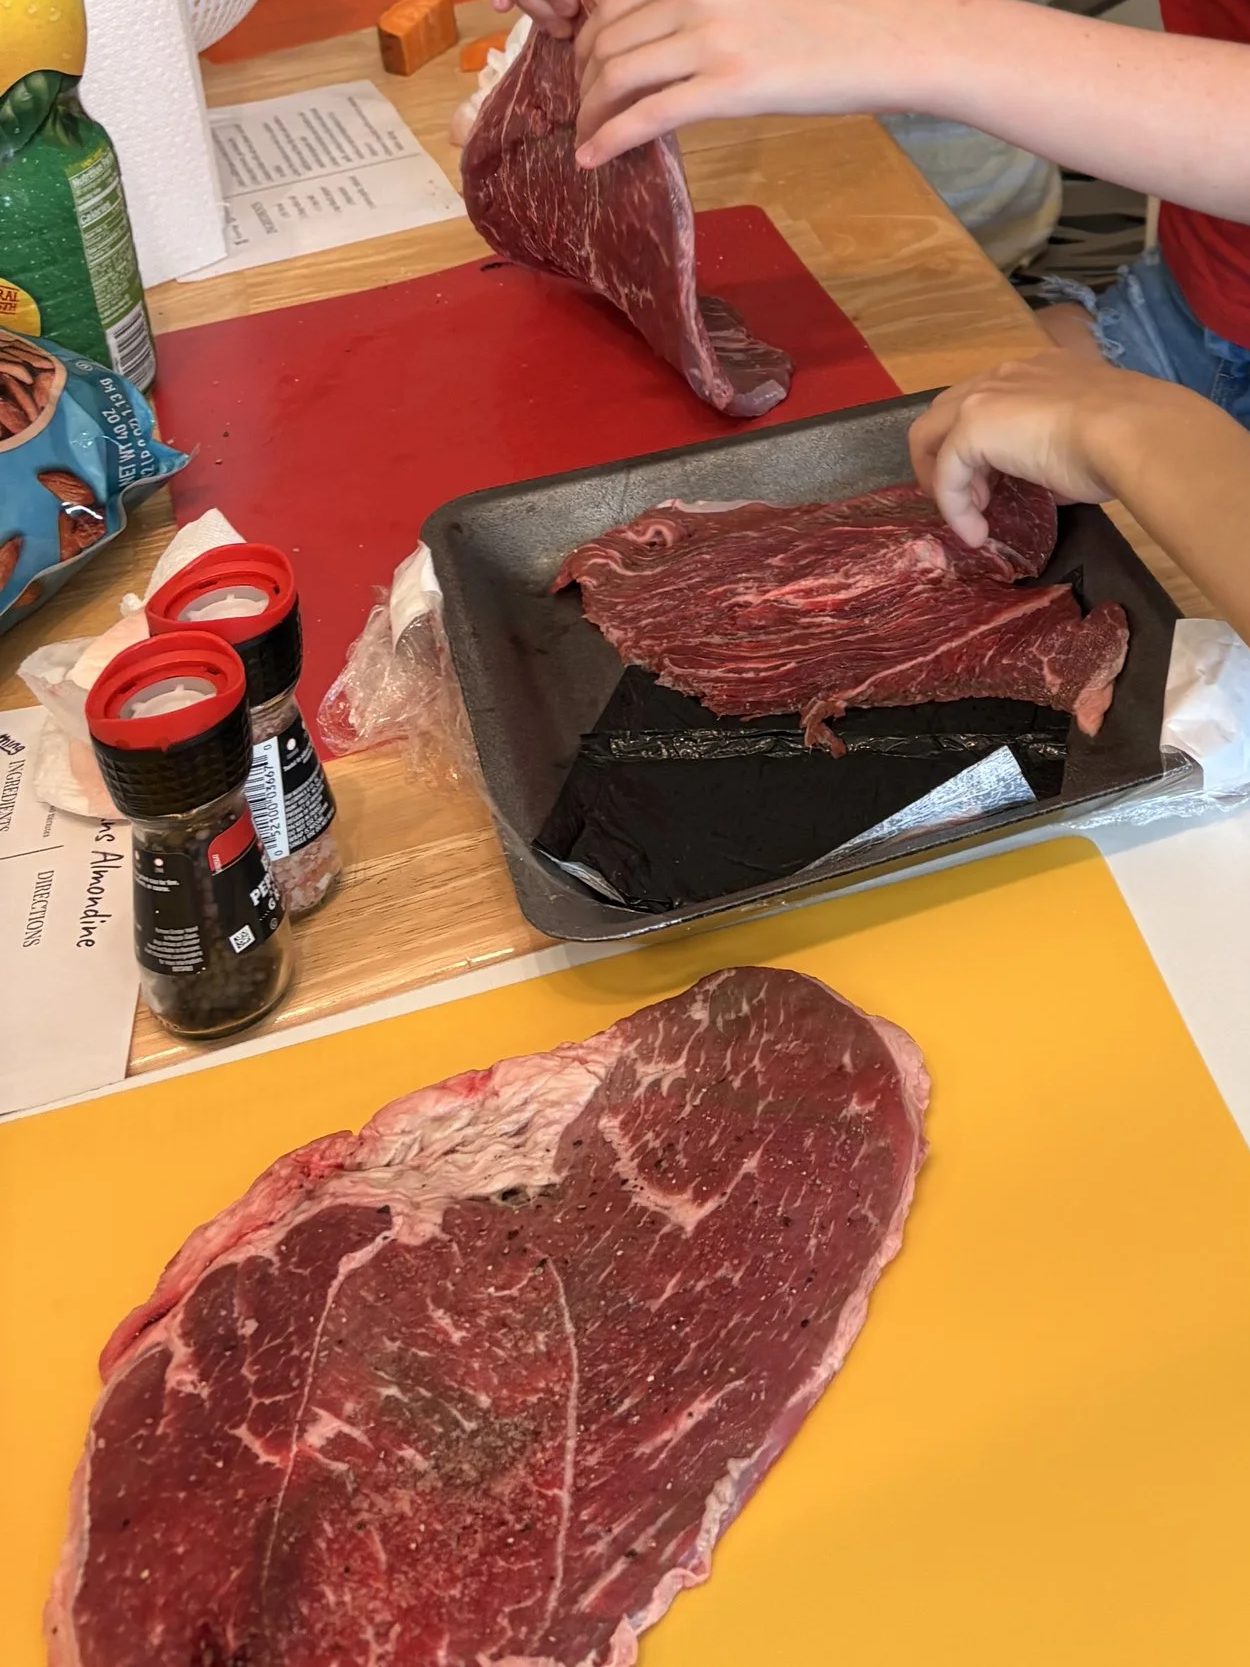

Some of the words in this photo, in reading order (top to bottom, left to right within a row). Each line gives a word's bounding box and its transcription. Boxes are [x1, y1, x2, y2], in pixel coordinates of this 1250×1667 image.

[99, 377, 116, 393] kg
[101, 408, 121, 424] OZ
[109, 393, 132, 417] 1.13
[113, 424, 129, 440] 40
[118, 443, 136, 463] WT
[118, 464, 136, 487] NET
[0, 759, 25, 832] INGREDIENTS
[22, 870, 54, 948] DIRECTIONS
[76, 850, 124, 948] Almondine
